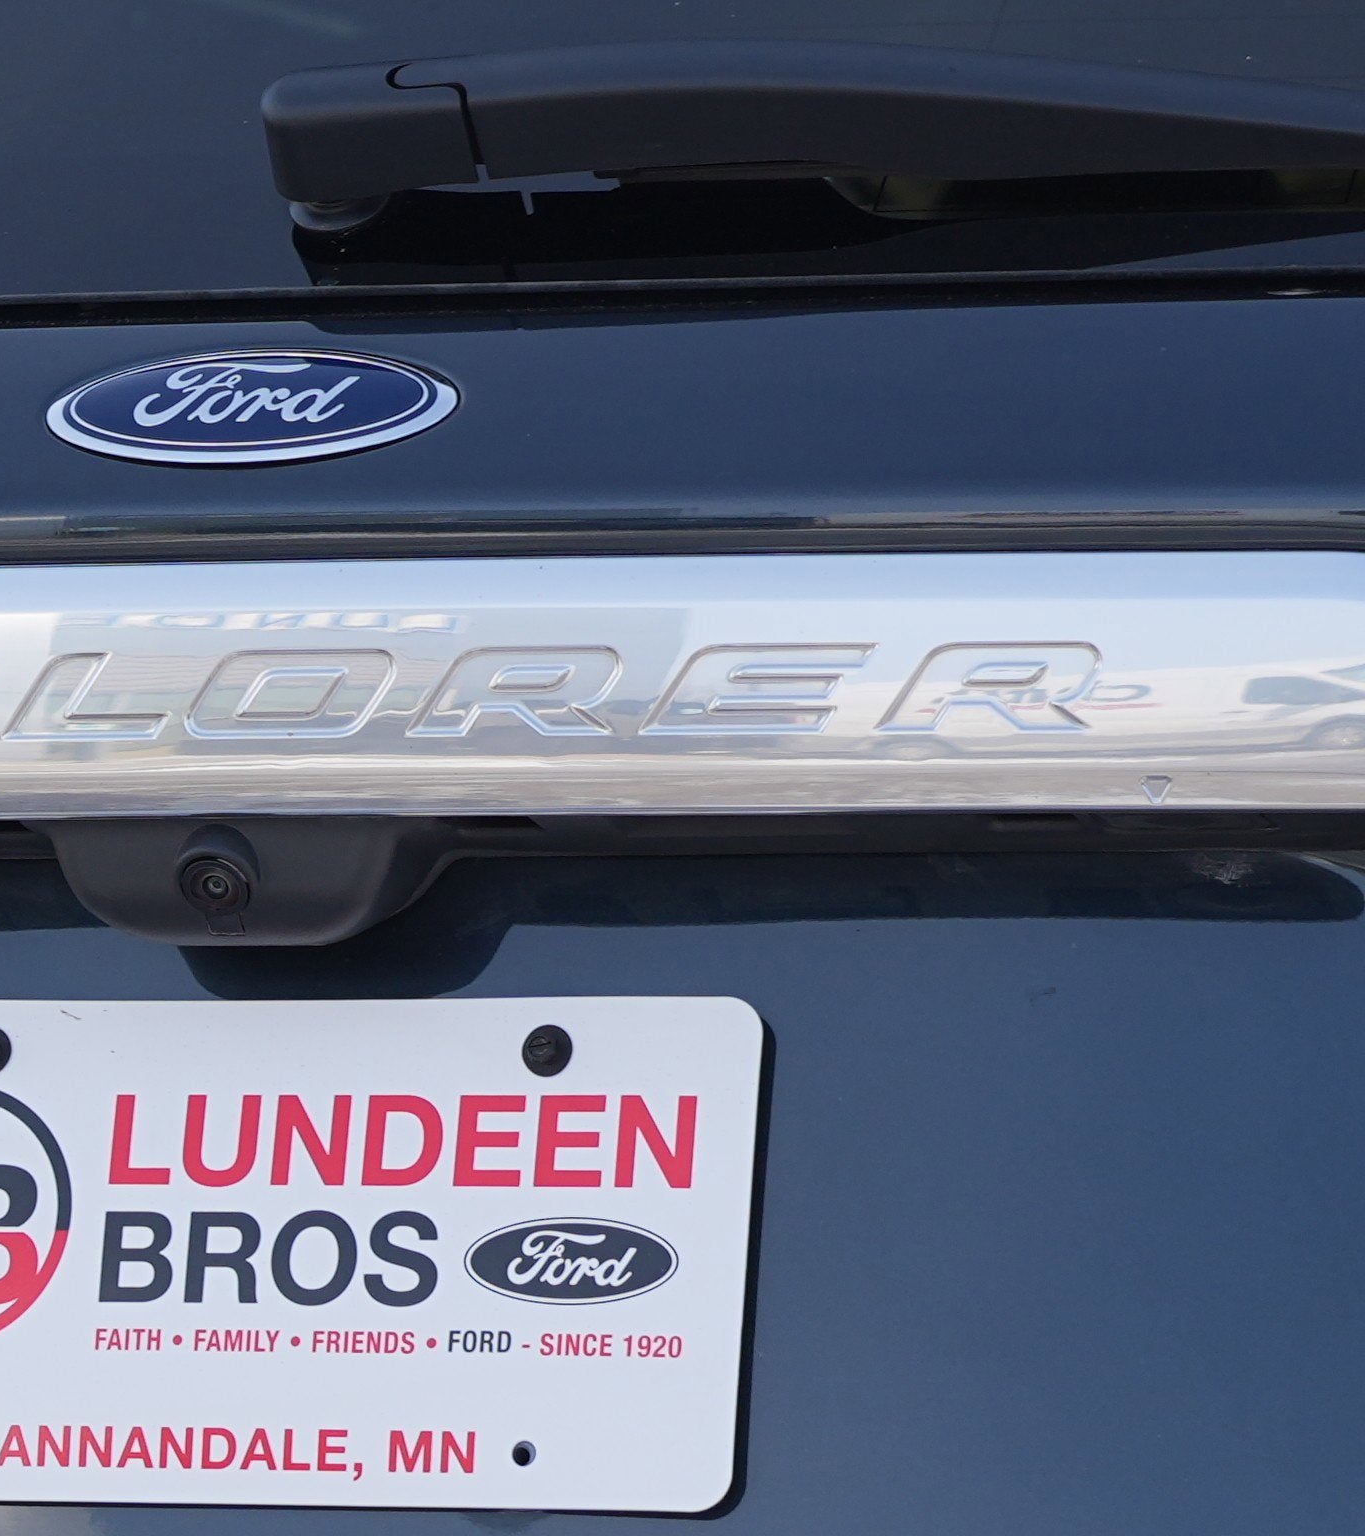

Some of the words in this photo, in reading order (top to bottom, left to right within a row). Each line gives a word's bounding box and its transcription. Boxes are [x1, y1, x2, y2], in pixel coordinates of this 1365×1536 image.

[133, 361, 360, 427] Ford
[107, 1093, 698, 1188] LUNDEEN
[99, 1209, 438, 1306] BROS
[508, 1230, 633, 1290] Ford
[94, 1328, 162, 1352] FAITH
[193, 1329, 280, 1353] FAMILY
[311, 1330, 416, 1355] FRIENDS
[447, 1330, 513, 1354] FORD
[539, 1333, 613, 1357] SINCE
[622, 1334, 683, 1359] 1920
[387, 1430, 476, 1474] MN
